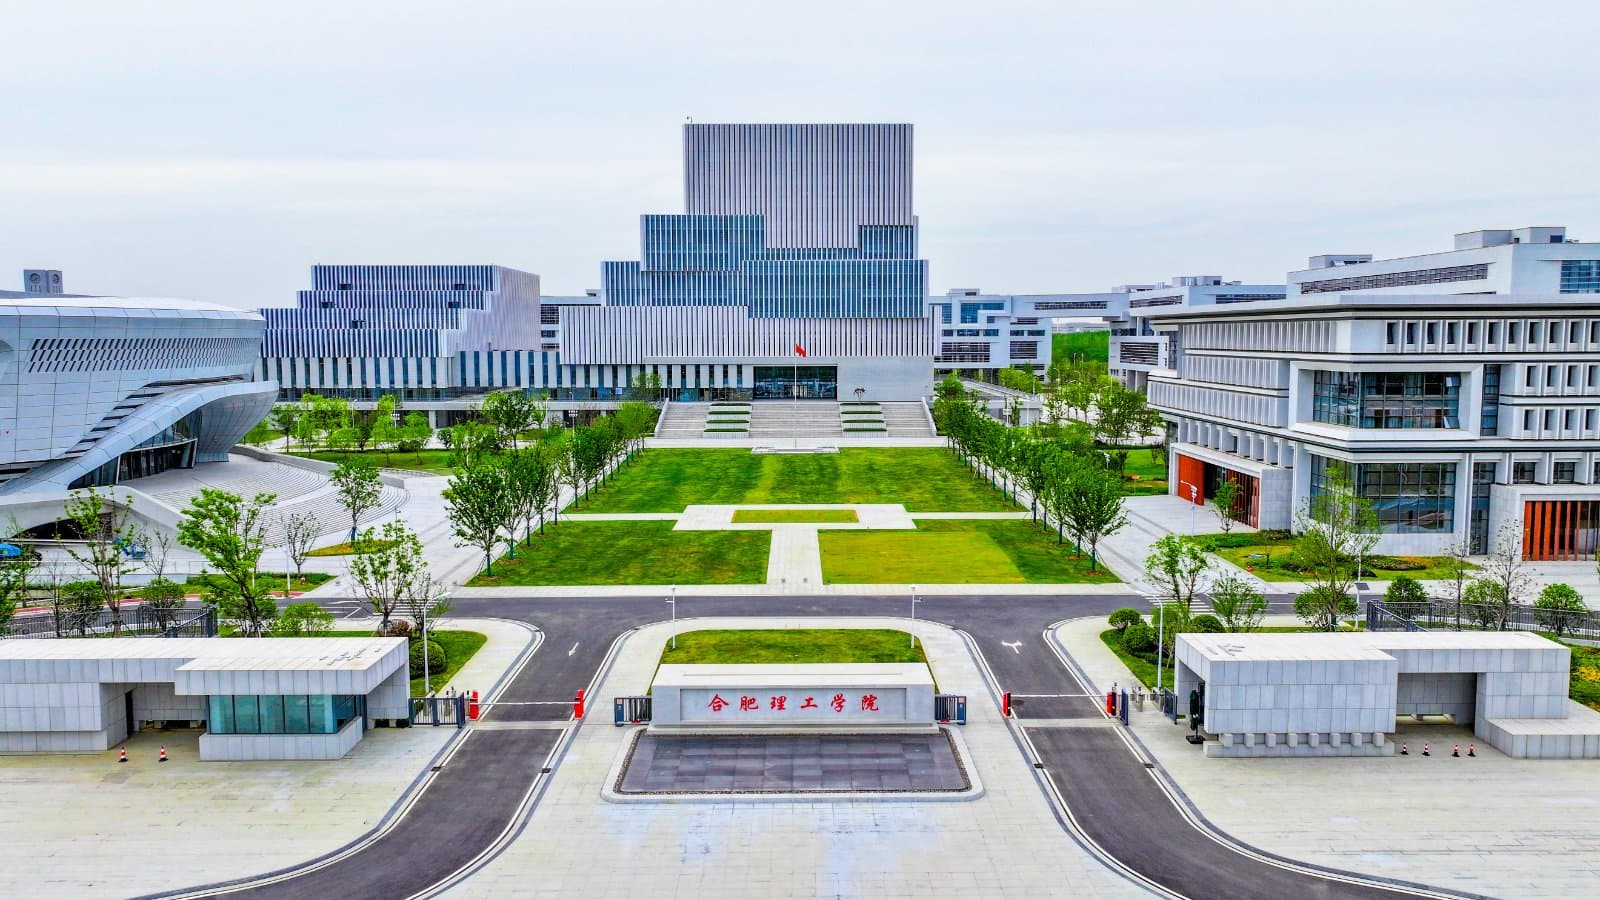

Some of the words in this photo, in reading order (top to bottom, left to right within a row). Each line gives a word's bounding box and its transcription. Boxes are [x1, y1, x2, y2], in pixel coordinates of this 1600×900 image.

[708, 693, 879, 712] 合肥理工学院
